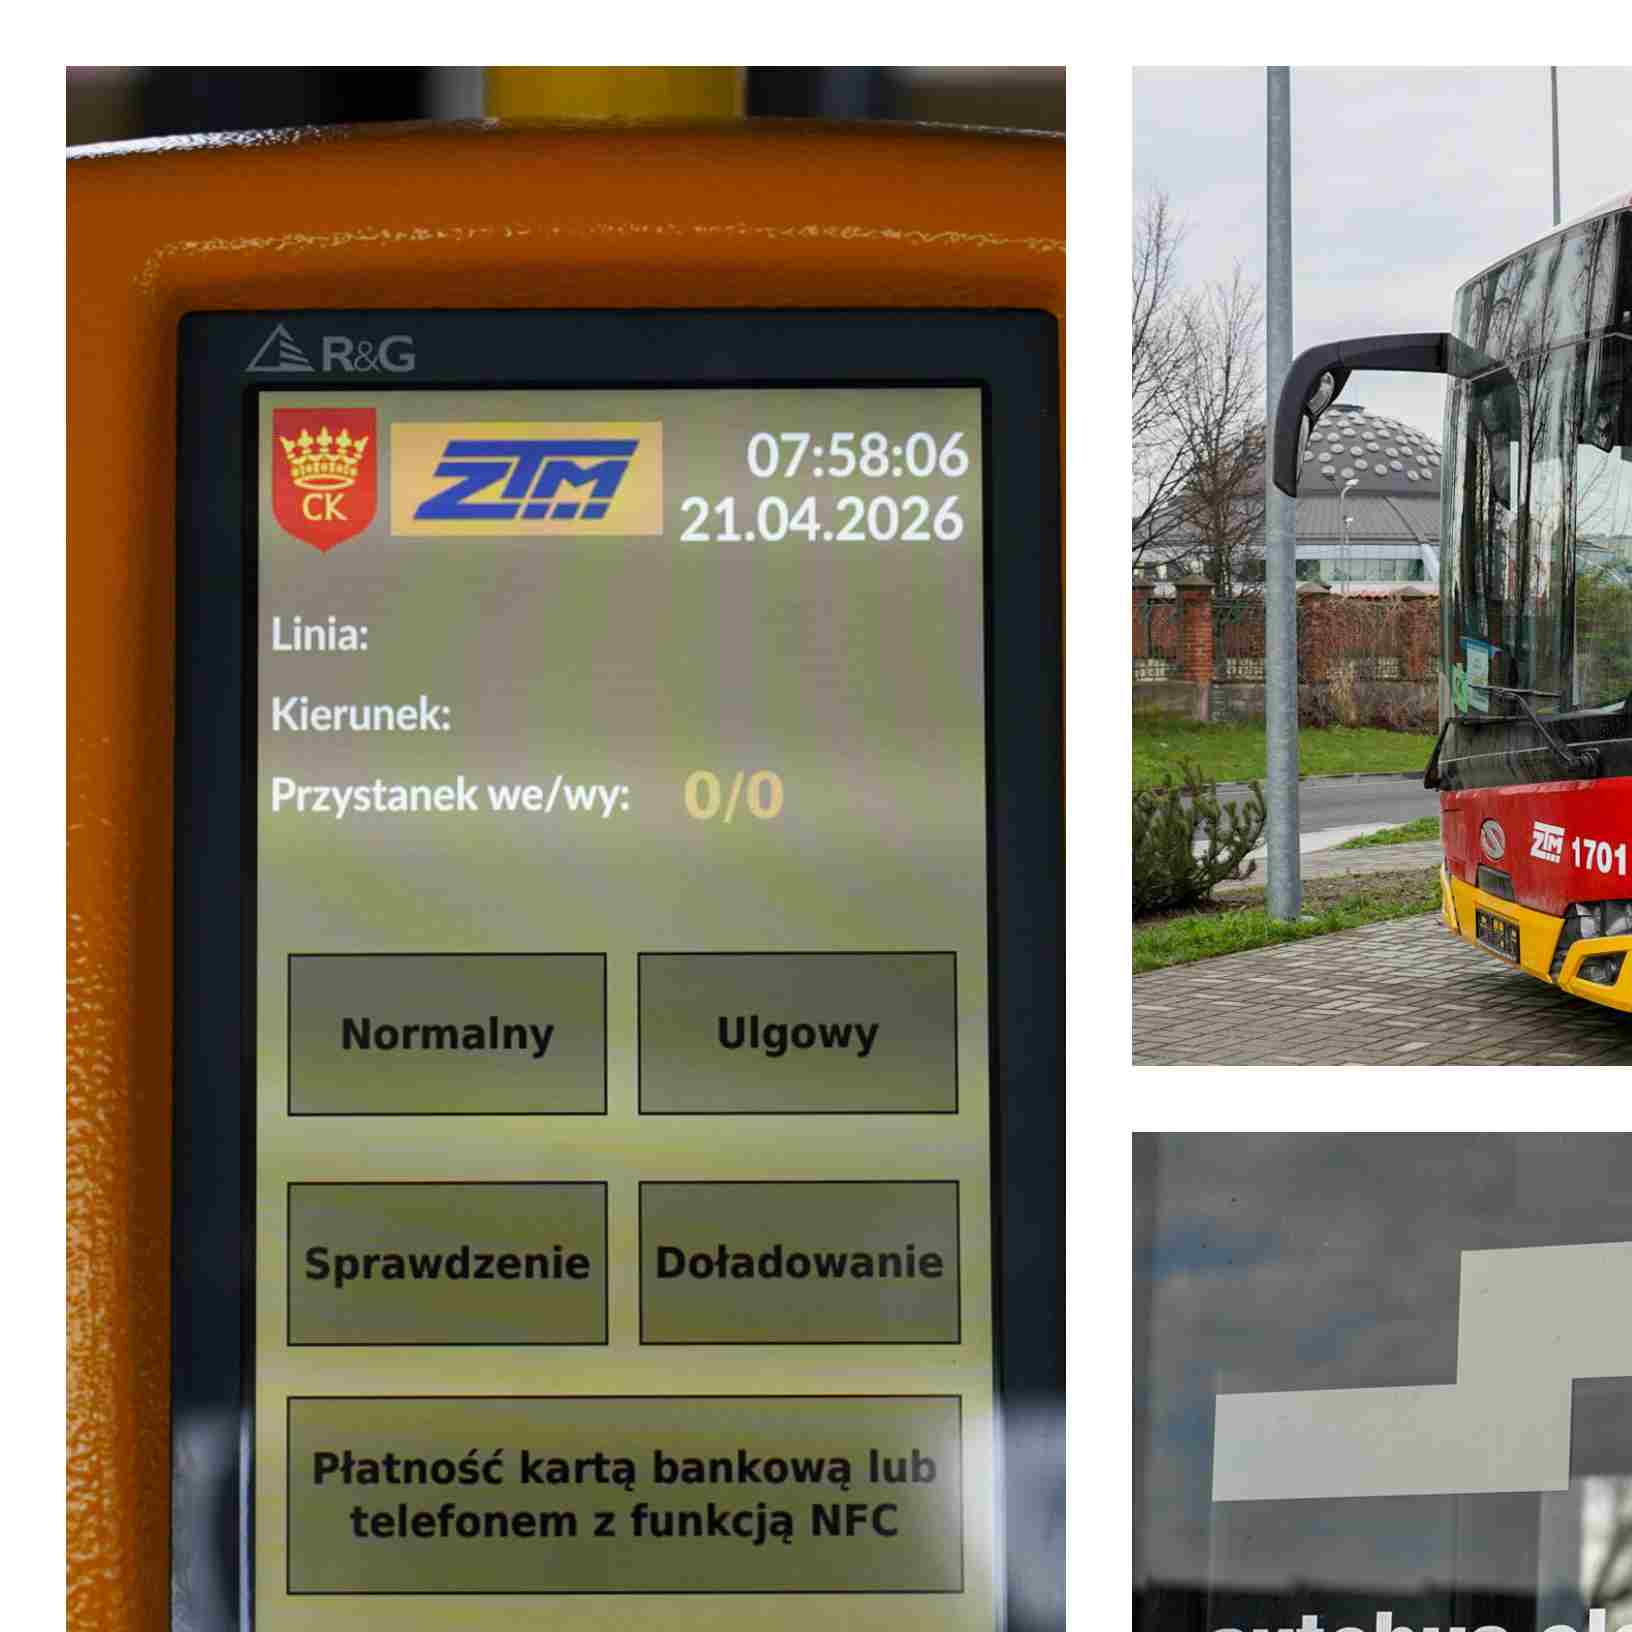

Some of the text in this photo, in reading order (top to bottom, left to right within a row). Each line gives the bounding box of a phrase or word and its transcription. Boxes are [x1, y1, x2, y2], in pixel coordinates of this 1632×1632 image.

[322, 335, 416, 373] R&G
[748, 432, 969, 477] 07:58:06
[413, 440, 640, 520] ZTM
[302, 493, 348, 521] CK
[680, 496, 964, 542] 21.04.2026
[272, 617, 368, 651] Linia:
[272, 697, 451, 732] Kierunek:
[272, 771, 784, 823] Przystanek we/wy: 0/0
[1572, 836, 1626, 876] 1701
[342, 1016, 554, 1057] Normalny
[718, 1015, 879, 1057] Ulgowy
[305, 1245, 590, 1289] Sprawdzenie
[656, 1244, 943, 1279] Doładowanie
[314, 1448, 936, 1492] Płatność kartą bankową lub
[350, 1503, 898, 1545] telefonem z funkcją NFC
